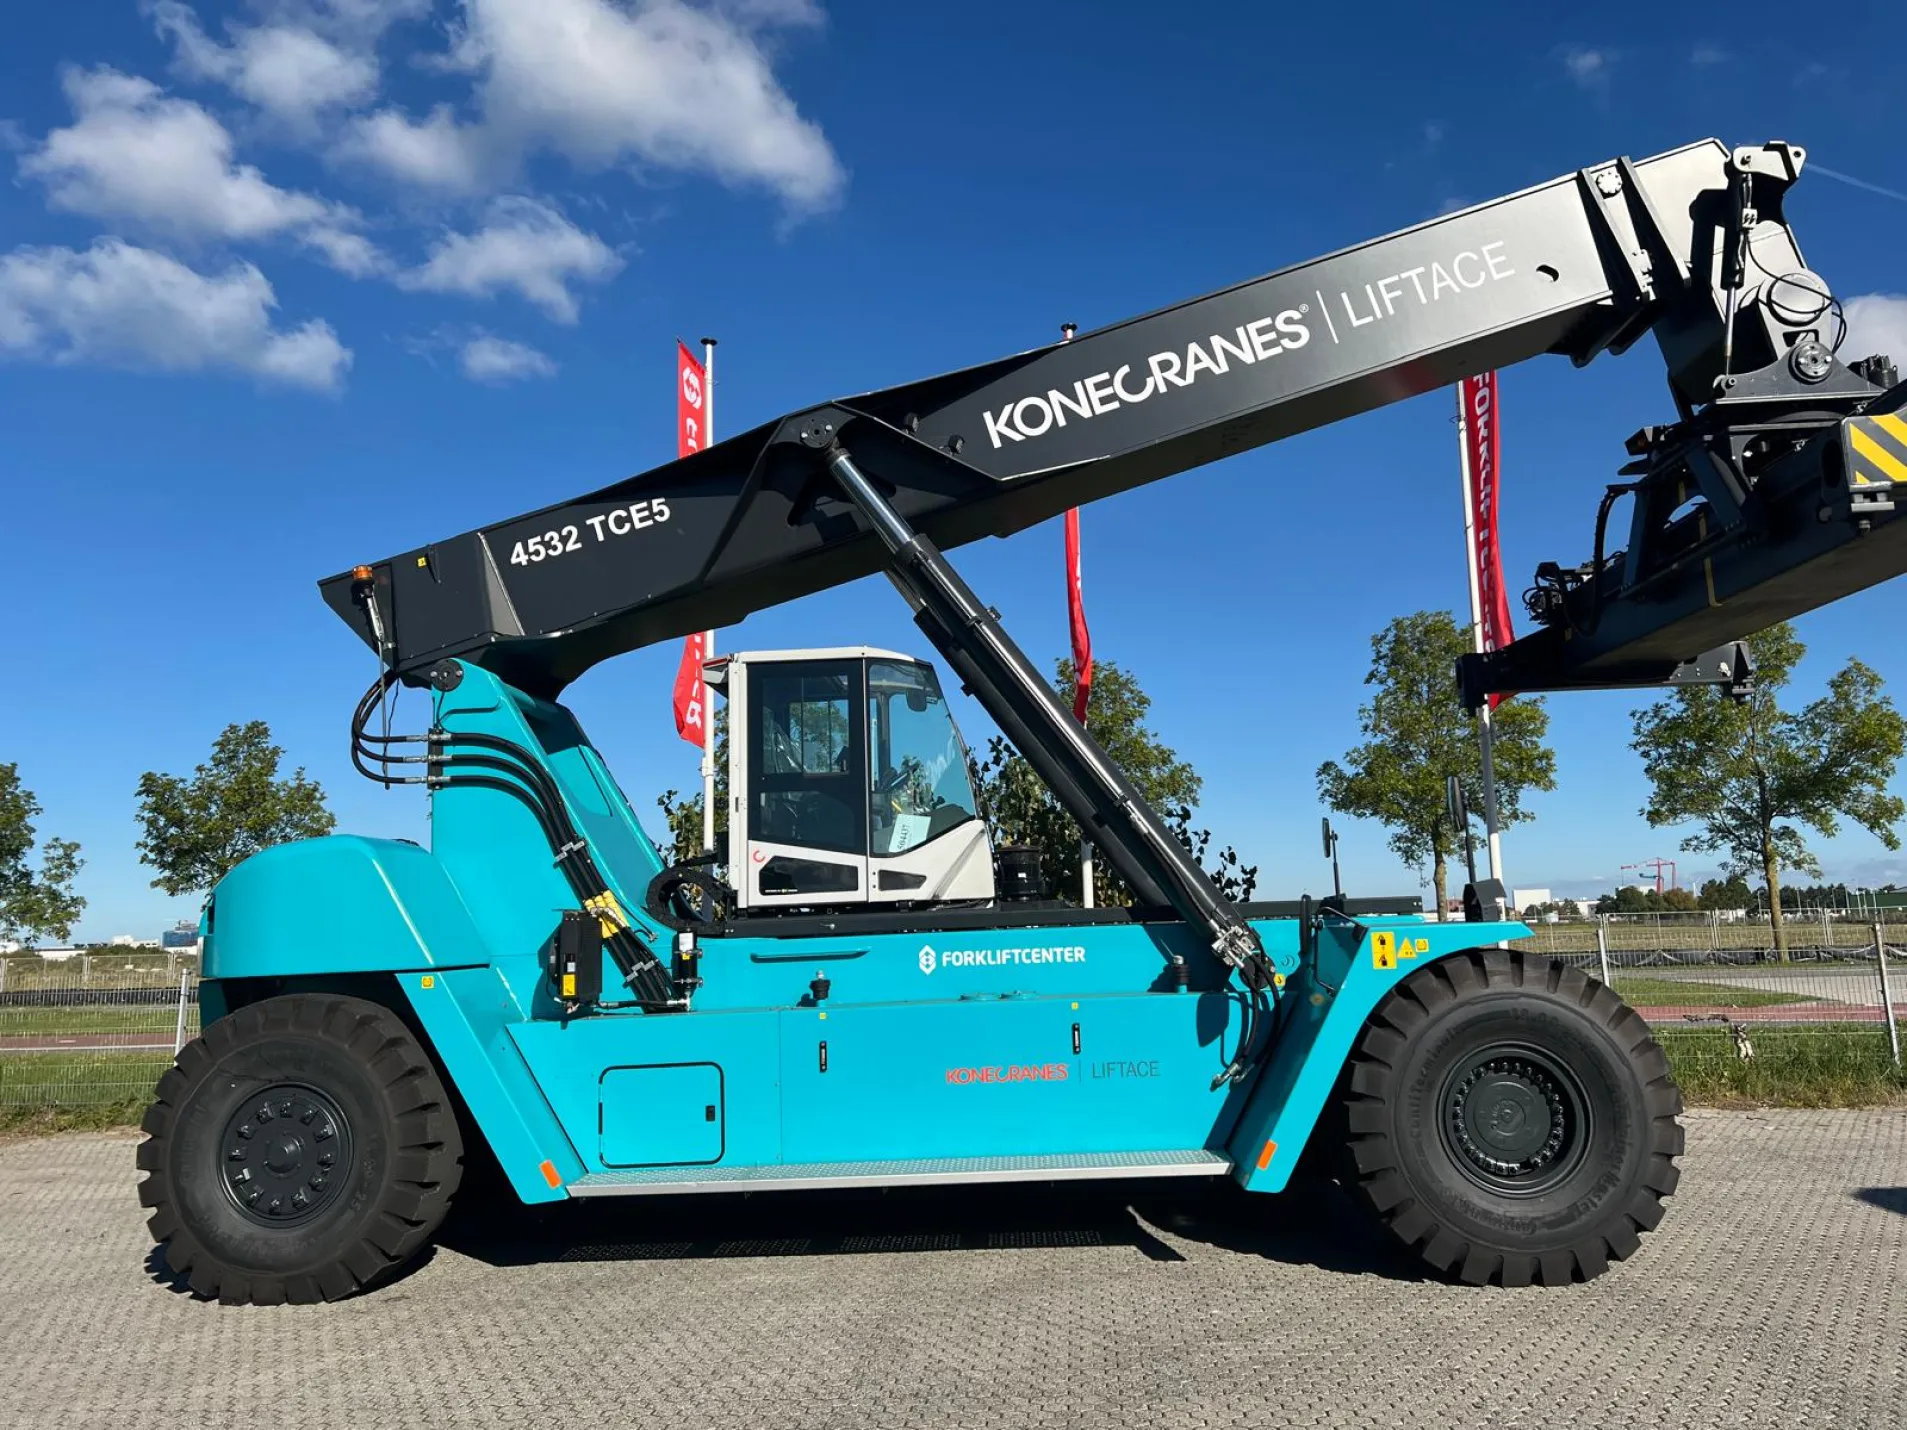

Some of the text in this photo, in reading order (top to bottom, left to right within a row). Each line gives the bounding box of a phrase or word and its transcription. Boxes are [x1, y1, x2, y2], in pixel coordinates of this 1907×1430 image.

[1341, 240, 1516, 327] LIFTACE
[510, 497, 671, 566] 4532 TCE5
[942, 946, 1086, 967] FORKLIFTCENTER
[946, 1060, 1161, 1084] KONECRANES LIFTACE
